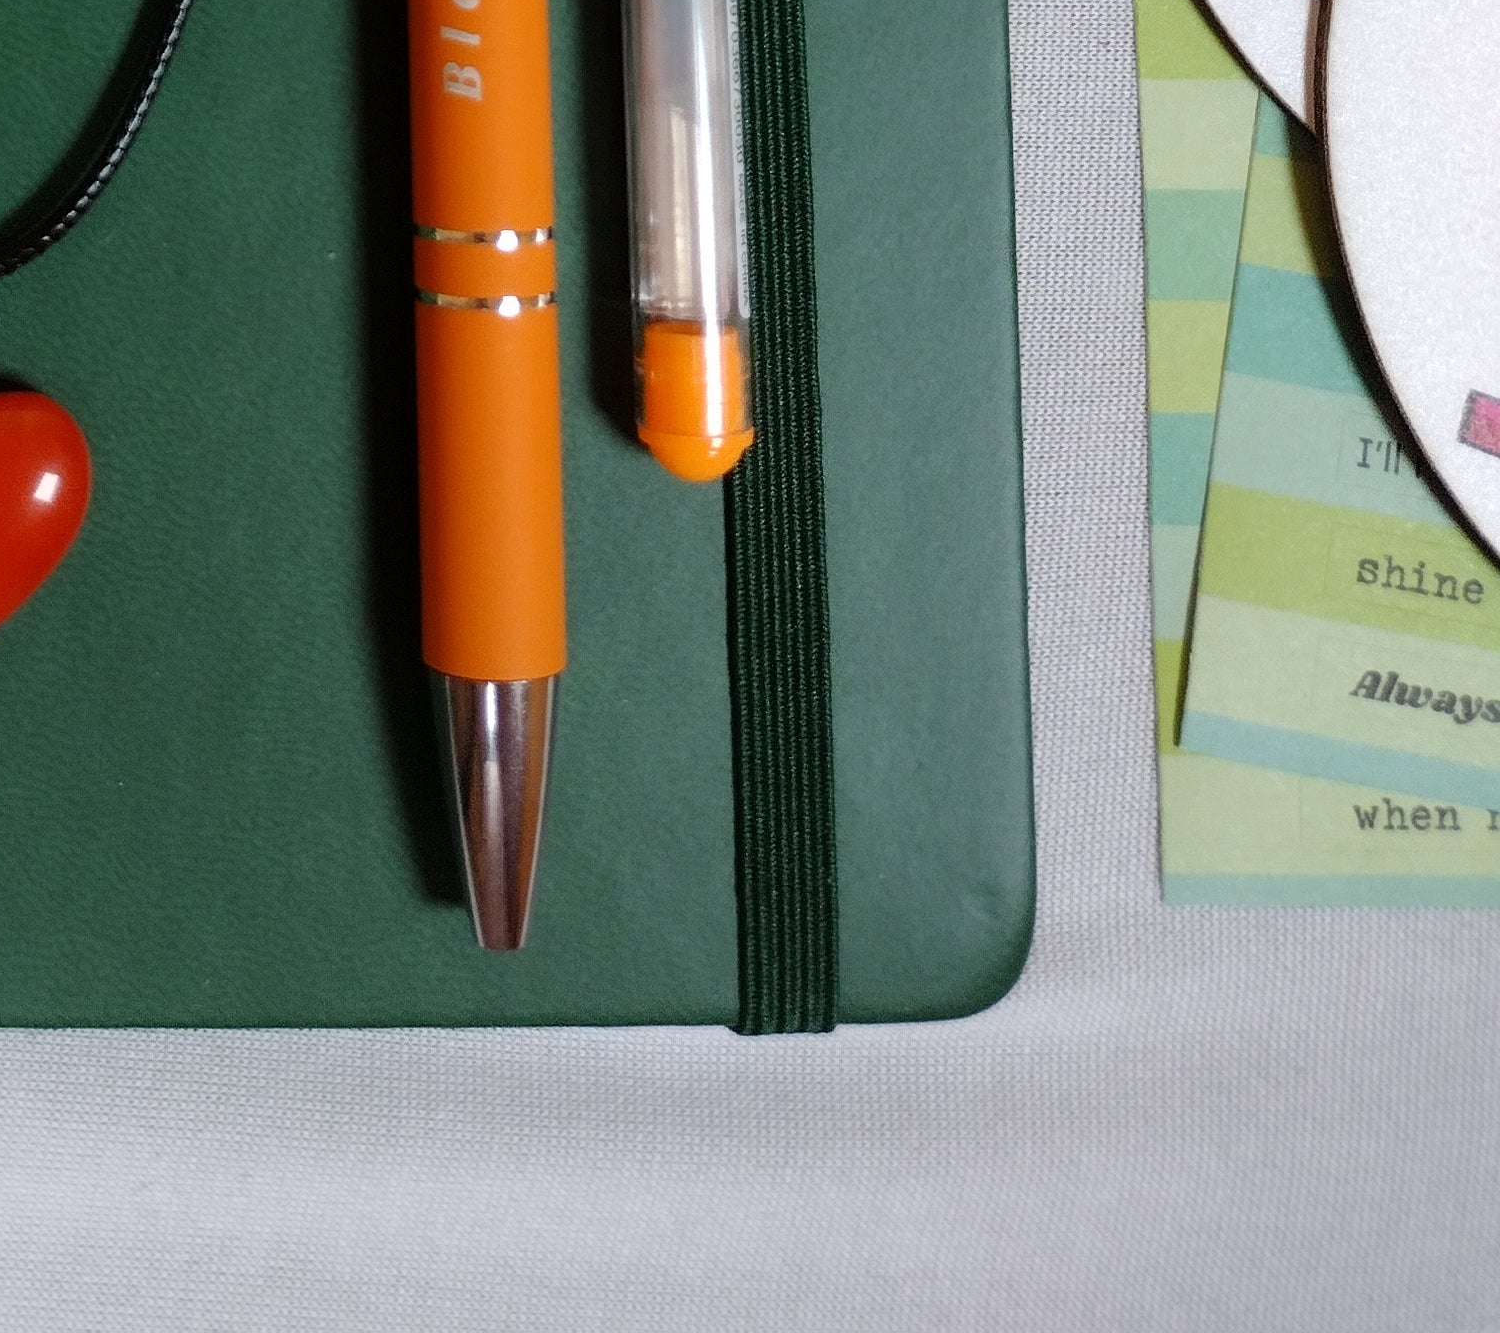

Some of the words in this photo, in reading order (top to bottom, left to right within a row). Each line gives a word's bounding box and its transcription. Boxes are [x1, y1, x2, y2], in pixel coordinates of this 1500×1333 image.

[1356, 554, 1485, 605] shine
[1349, 670, 1500, 725] Always
[1353, 798, 1461, 831] when
